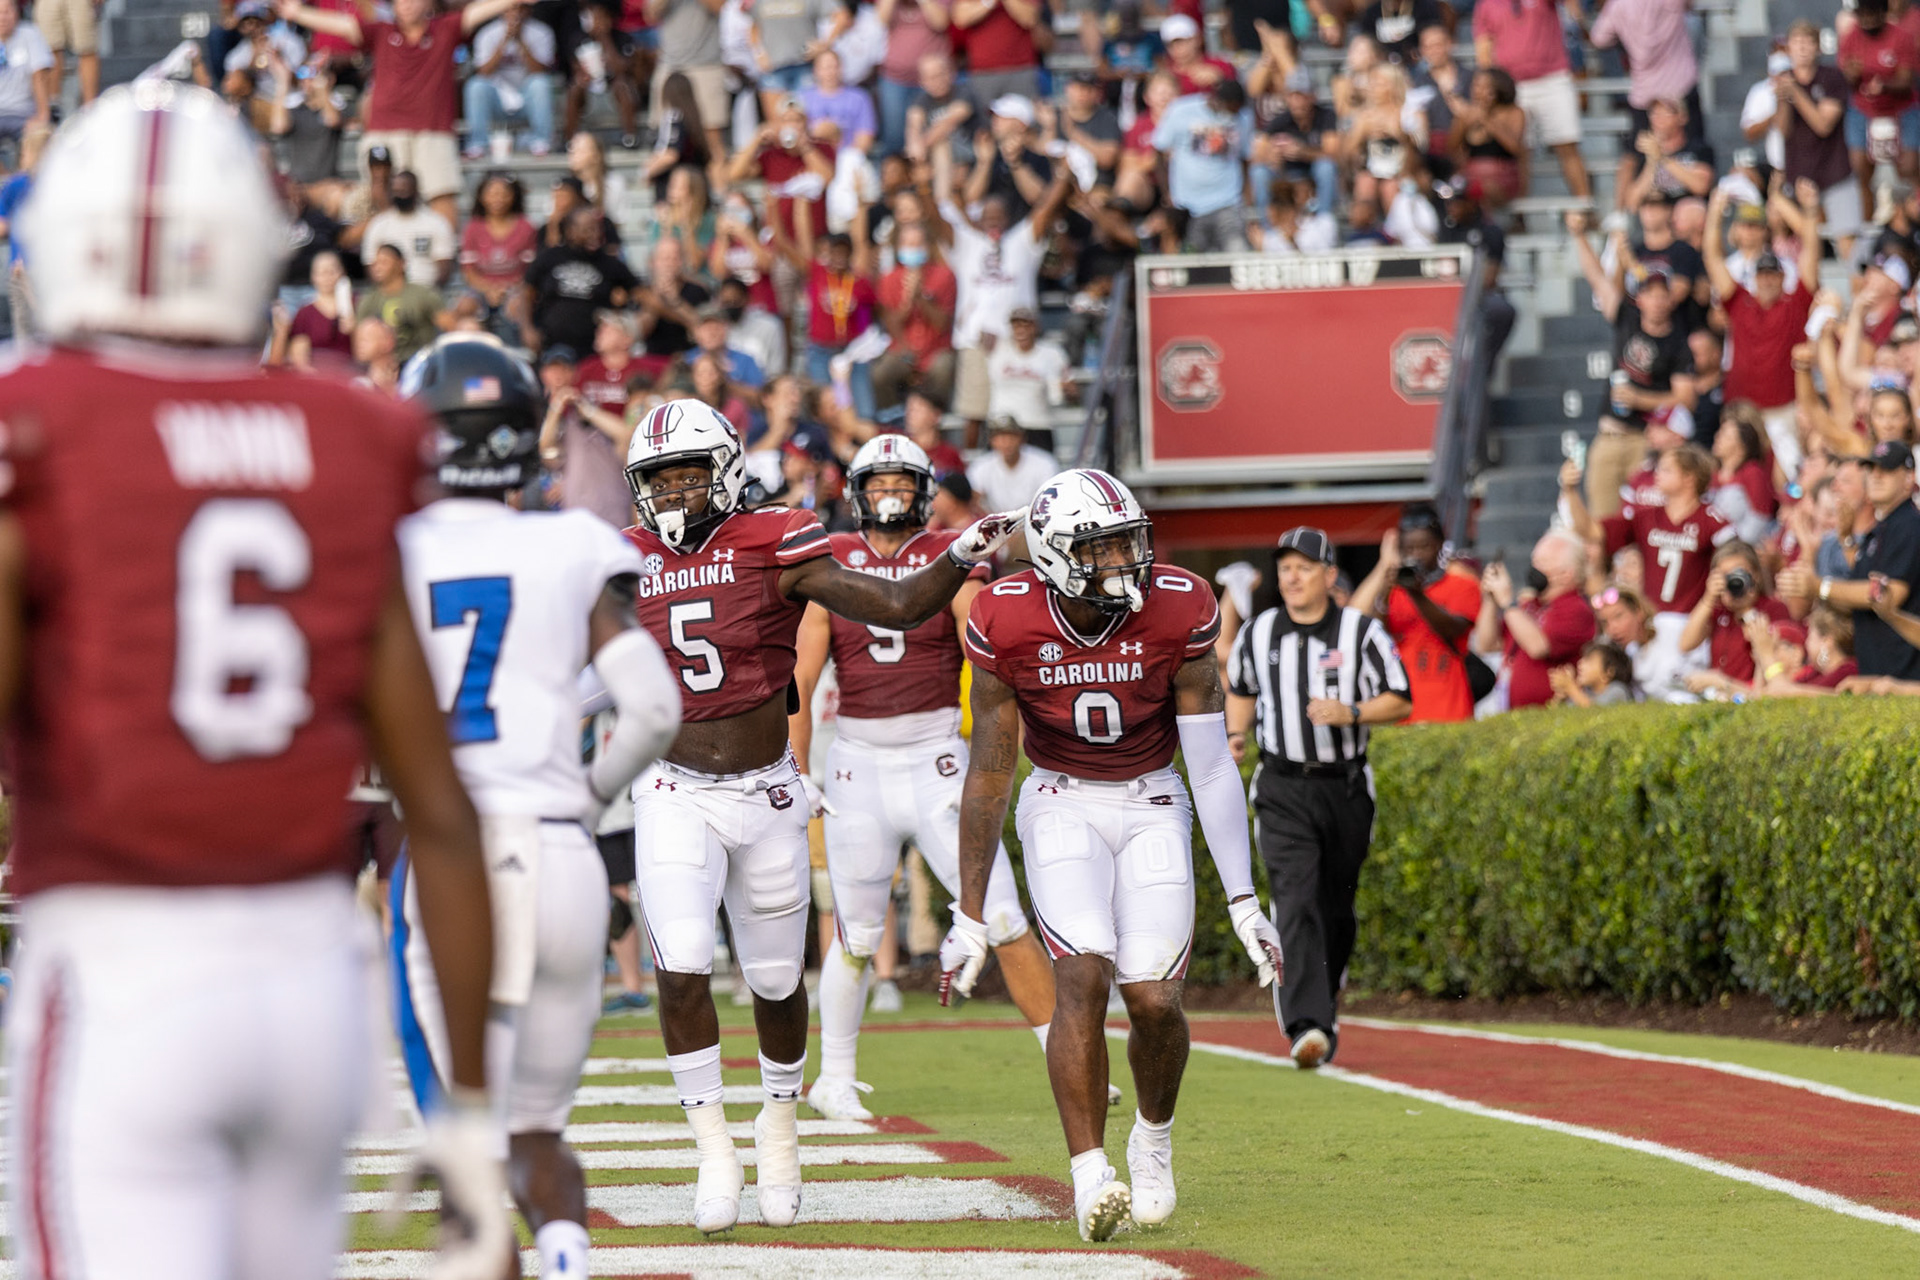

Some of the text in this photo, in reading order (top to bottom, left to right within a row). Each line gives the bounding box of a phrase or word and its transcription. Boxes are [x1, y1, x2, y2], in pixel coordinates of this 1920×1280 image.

[639, 562, 736, 599] CAROLINA
[644, 553, 664, 576] SEC
[1657, 546, 1683, 603] 7
[992, 581, 1030, 596] 0
[1155, 575, 1193, 592] 0
[172, 498, 313, 762] 6
[668, 598, 727, 695] 5
[429, 576, 512, 743] 7
[1039, 643, 1062, 662] SEC
[1038, 661, 1144, 686] CAROLINA
[1072, 689, 1124, 745] 0
